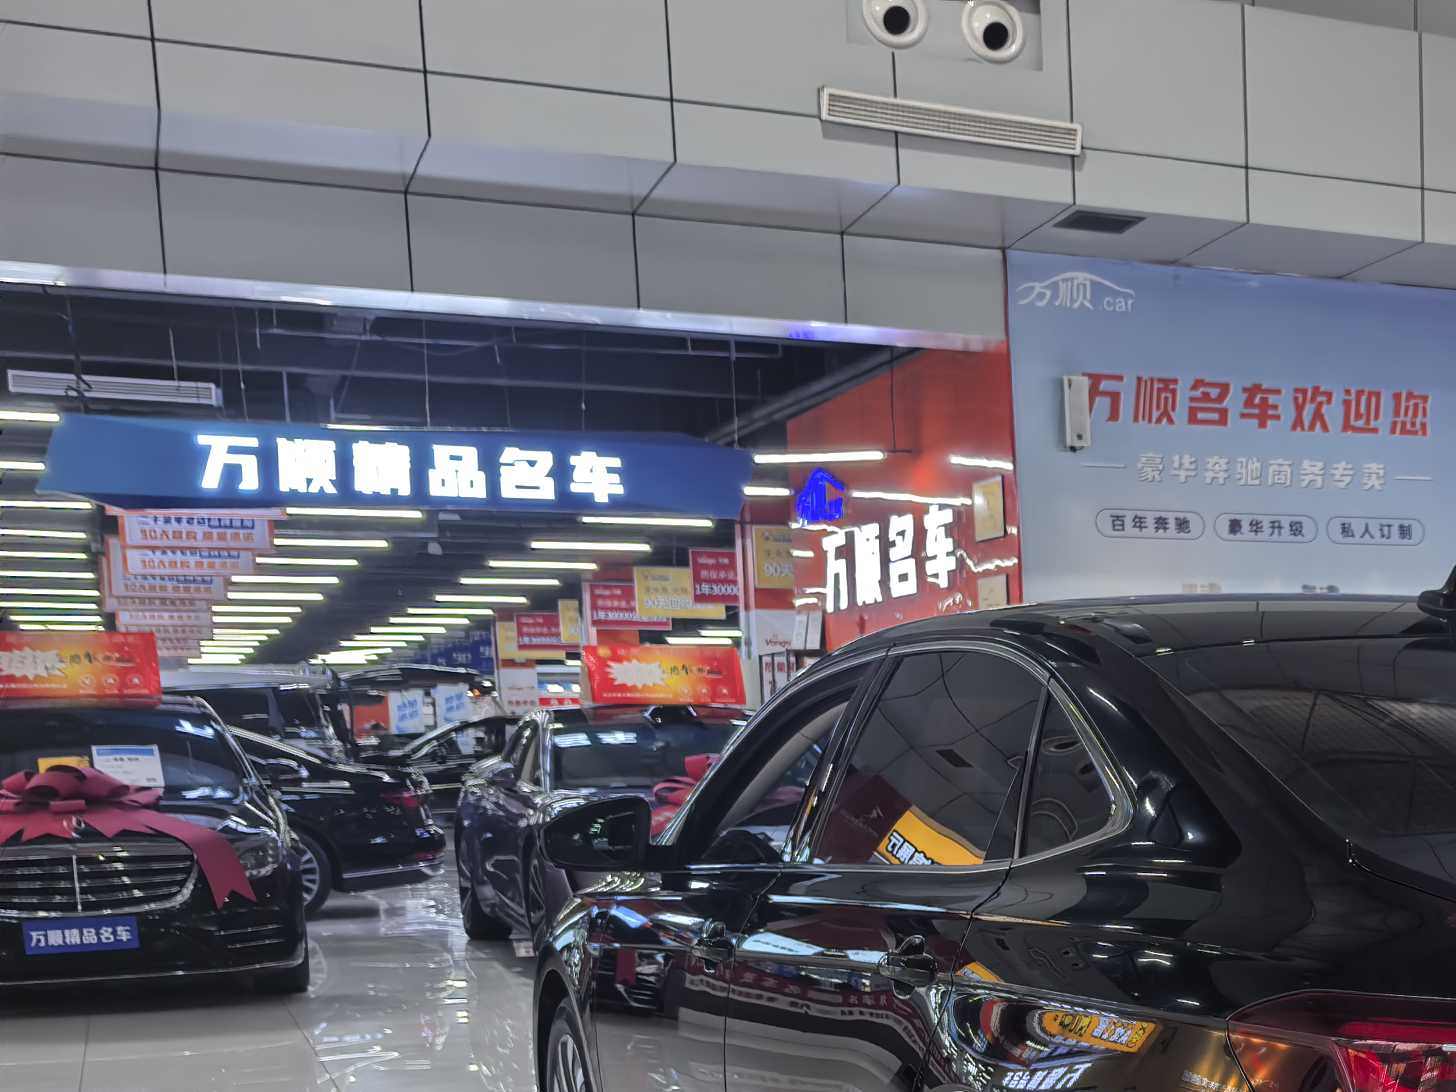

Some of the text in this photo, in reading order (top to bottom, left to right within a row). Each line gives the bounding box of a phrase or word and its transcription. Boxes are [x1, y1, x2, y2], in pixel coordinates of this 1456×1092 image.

[1103, 297, 1135, 313] car
[1083, 371, 1432, 438] 万顺名车欢迎您
[197, 434, 626, 503] 万顺精品名车
[1136, 452, 1387, 492] 豪华奔驰商务专卖
[1109, 513, 1192, 536] 百年奔驰
[1227, 517, 1306, 539] 豪华升级
[1339, 521, 1414, 541] 私人订制
[821, 504, 957, 613] 万顺名车
[29, 926, 132, 947] 万顺精品名车
